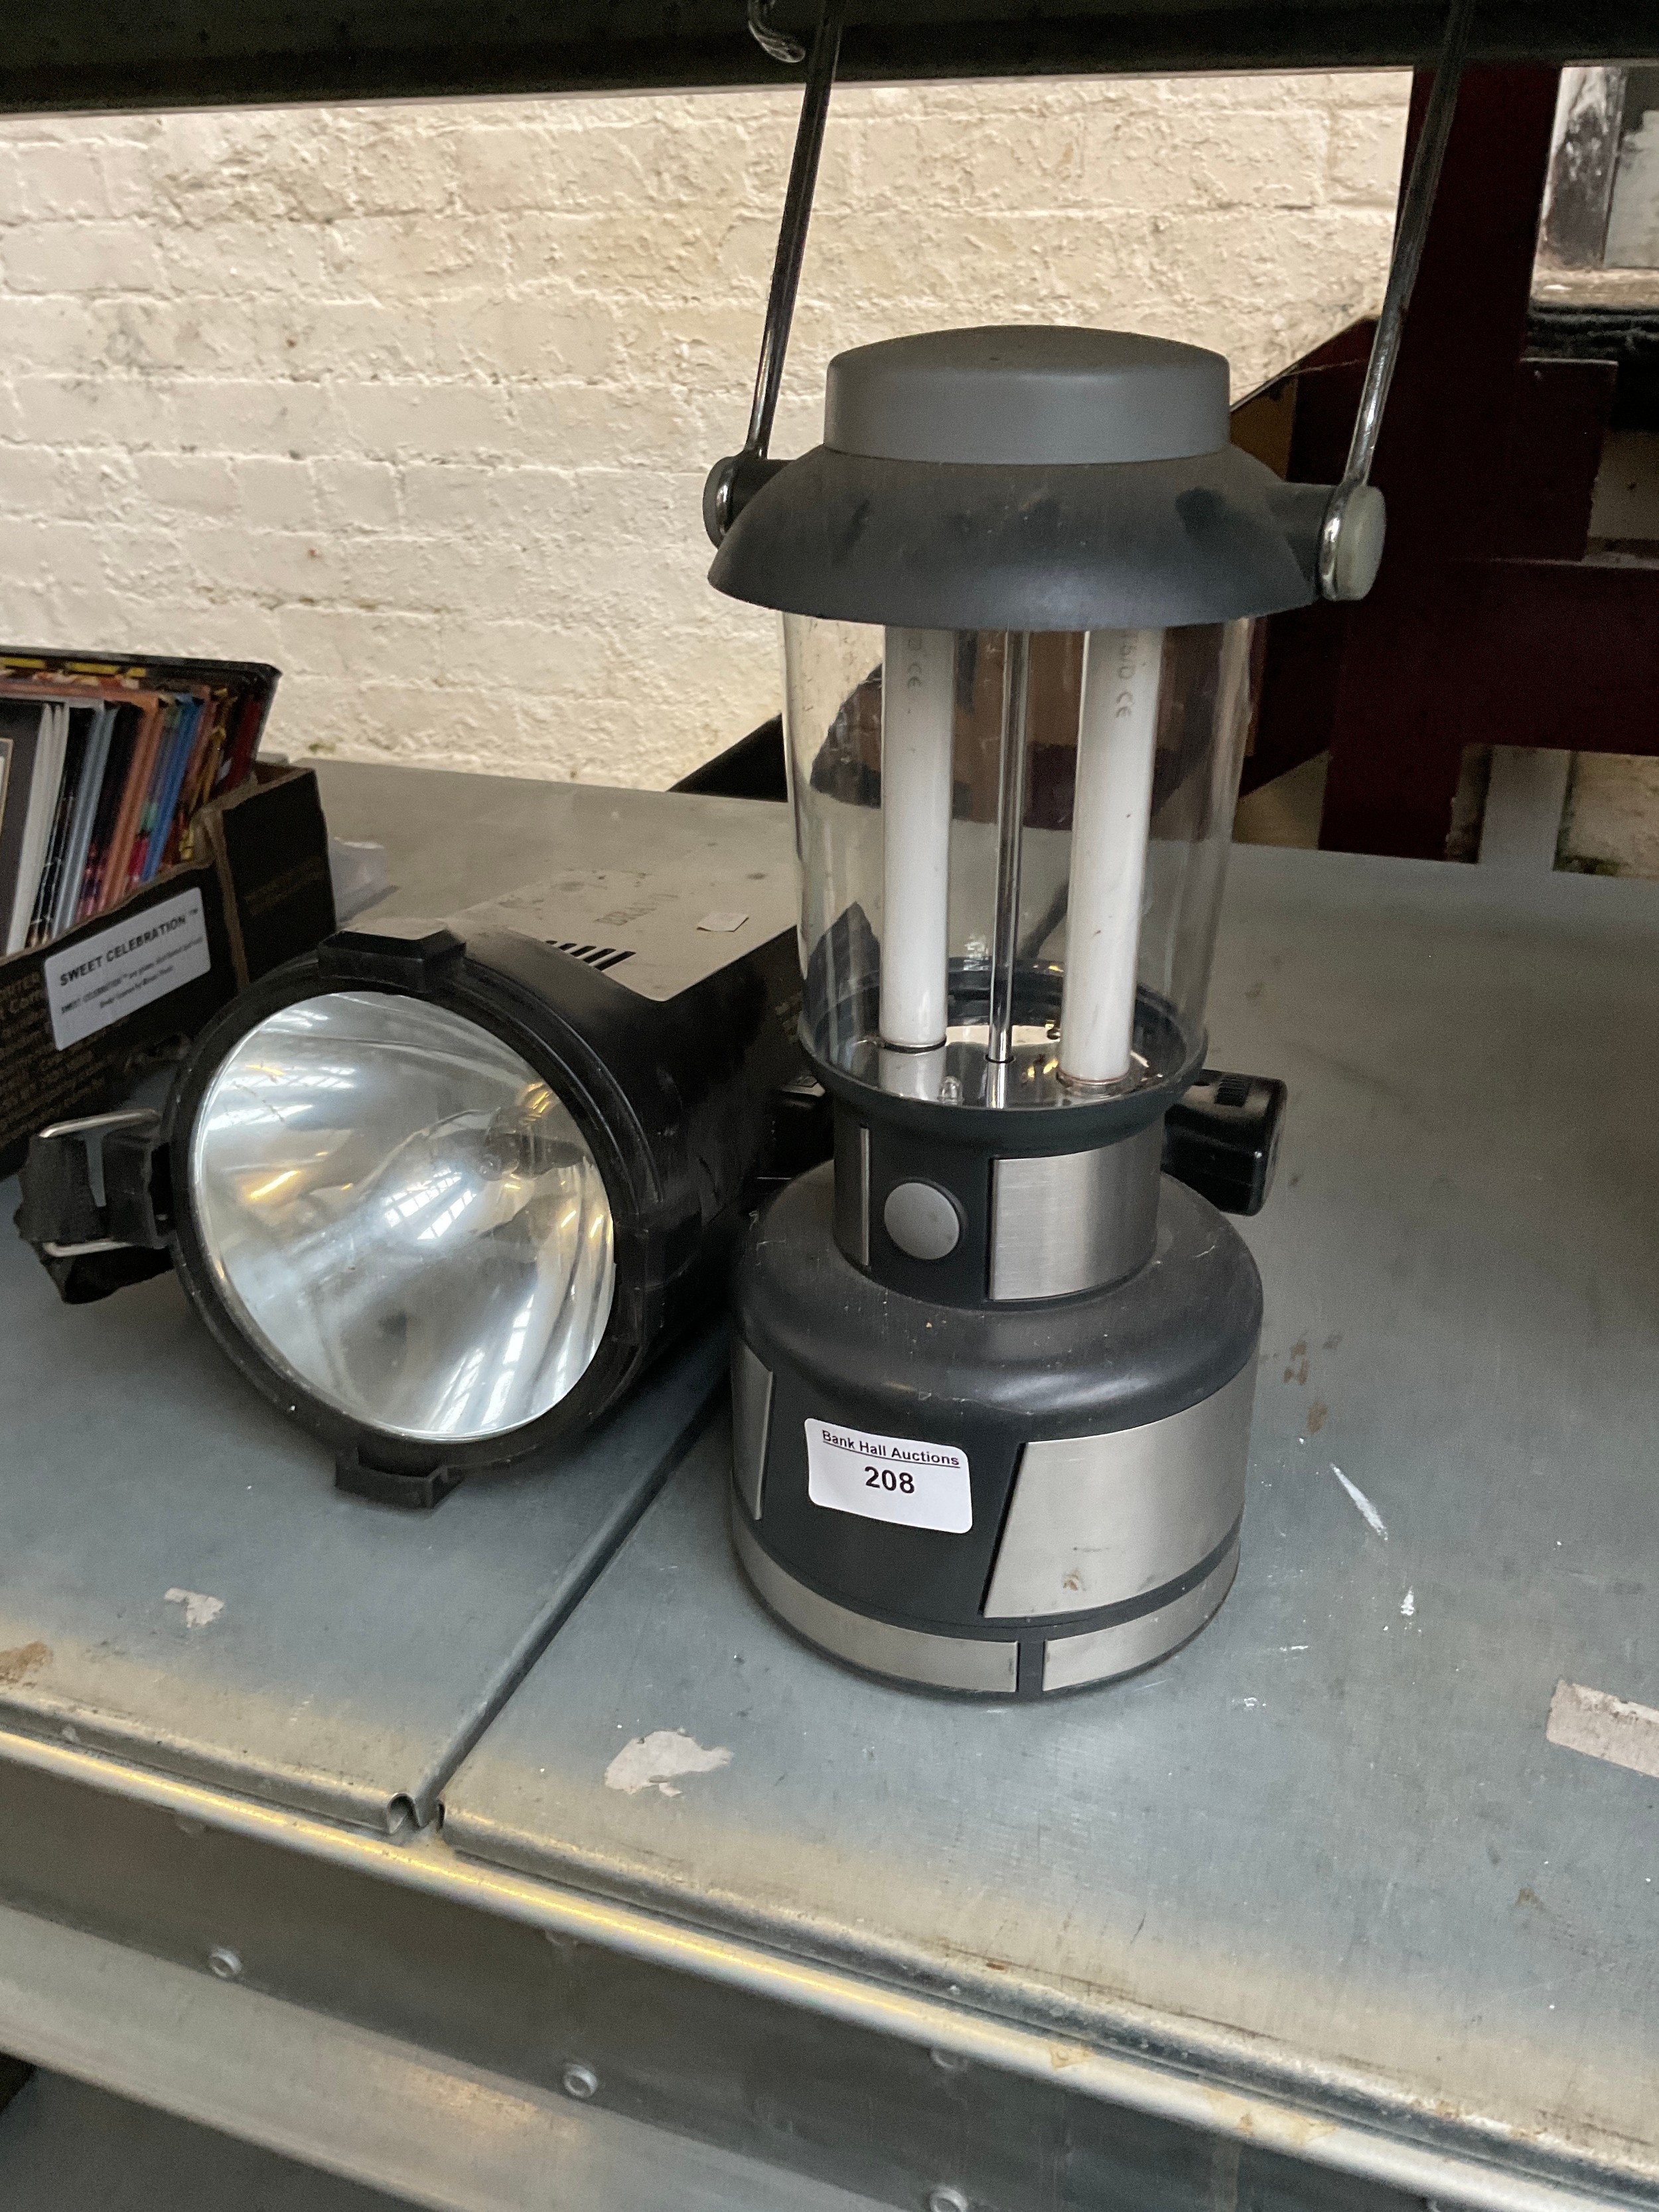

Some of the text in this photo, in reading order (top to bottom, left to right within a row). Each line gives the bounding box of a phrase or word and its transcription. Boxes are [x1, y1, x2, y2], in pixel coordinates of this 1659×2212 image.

[60, 955, 103, 987] SWEET
[106, 914, 186, 963] CELEBRATION
[822, 1429, 960, 1466] Bank Hall Auctions
[864, 1465, 916, 1494] 208
